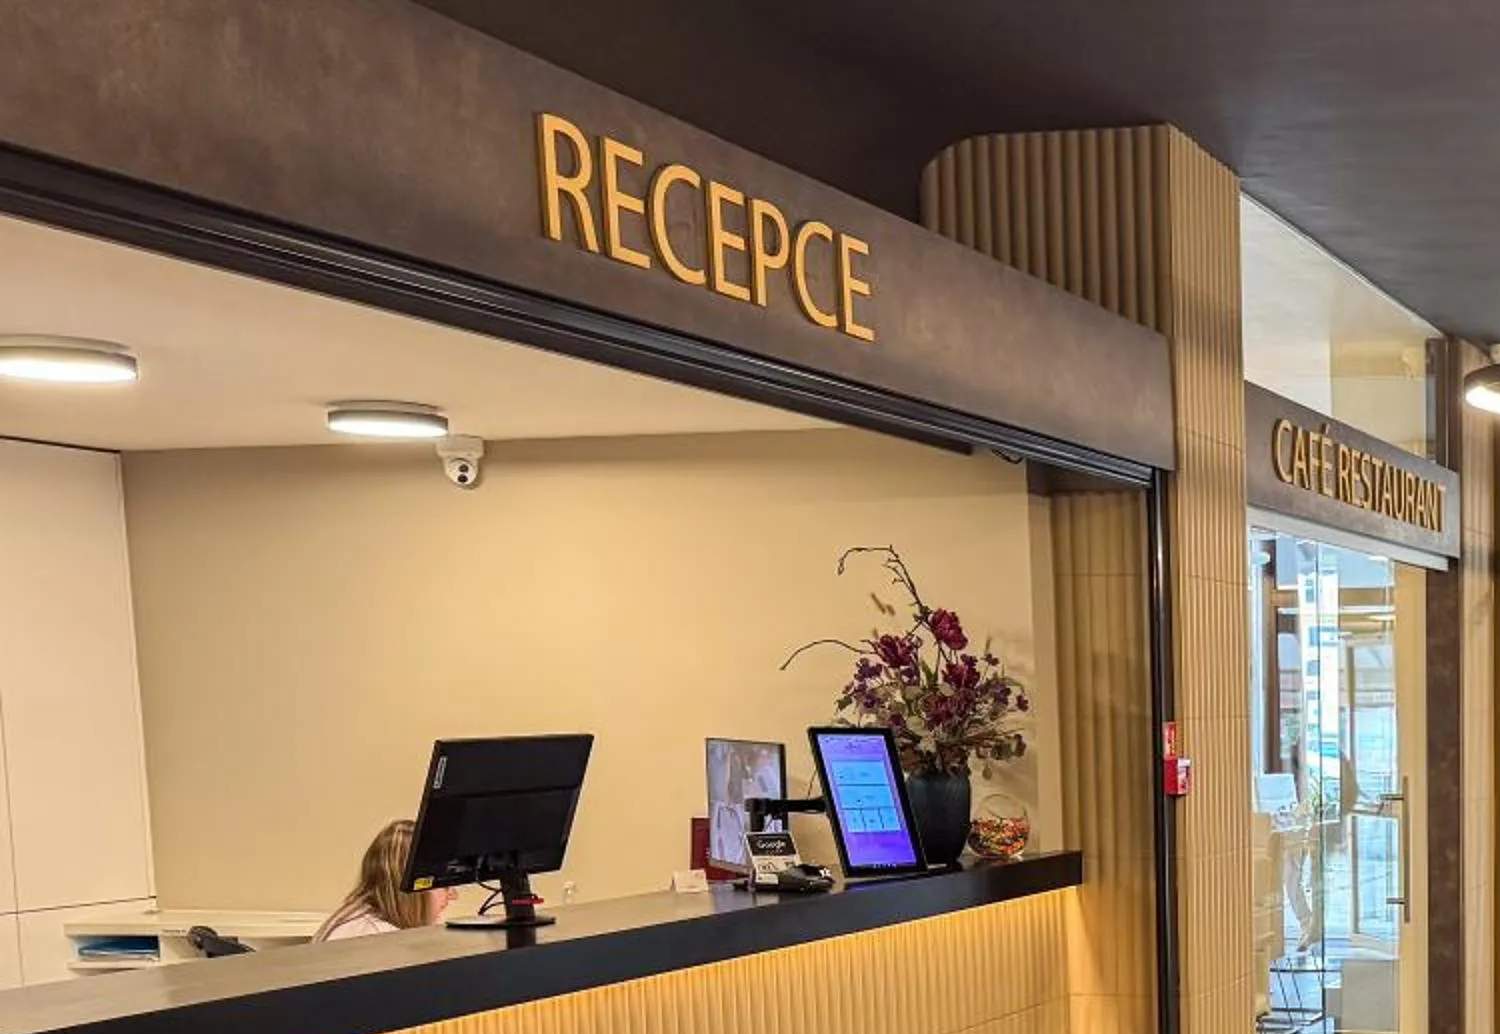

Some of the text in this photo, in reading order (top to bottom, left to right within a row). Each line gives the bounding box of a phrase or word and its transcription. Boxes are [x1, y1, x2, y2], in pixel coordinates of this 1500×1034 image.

[539, 112, 875, 342] RECEPCE
[1272, 418, 1446, 533] CAFÉ RESTAURANT
